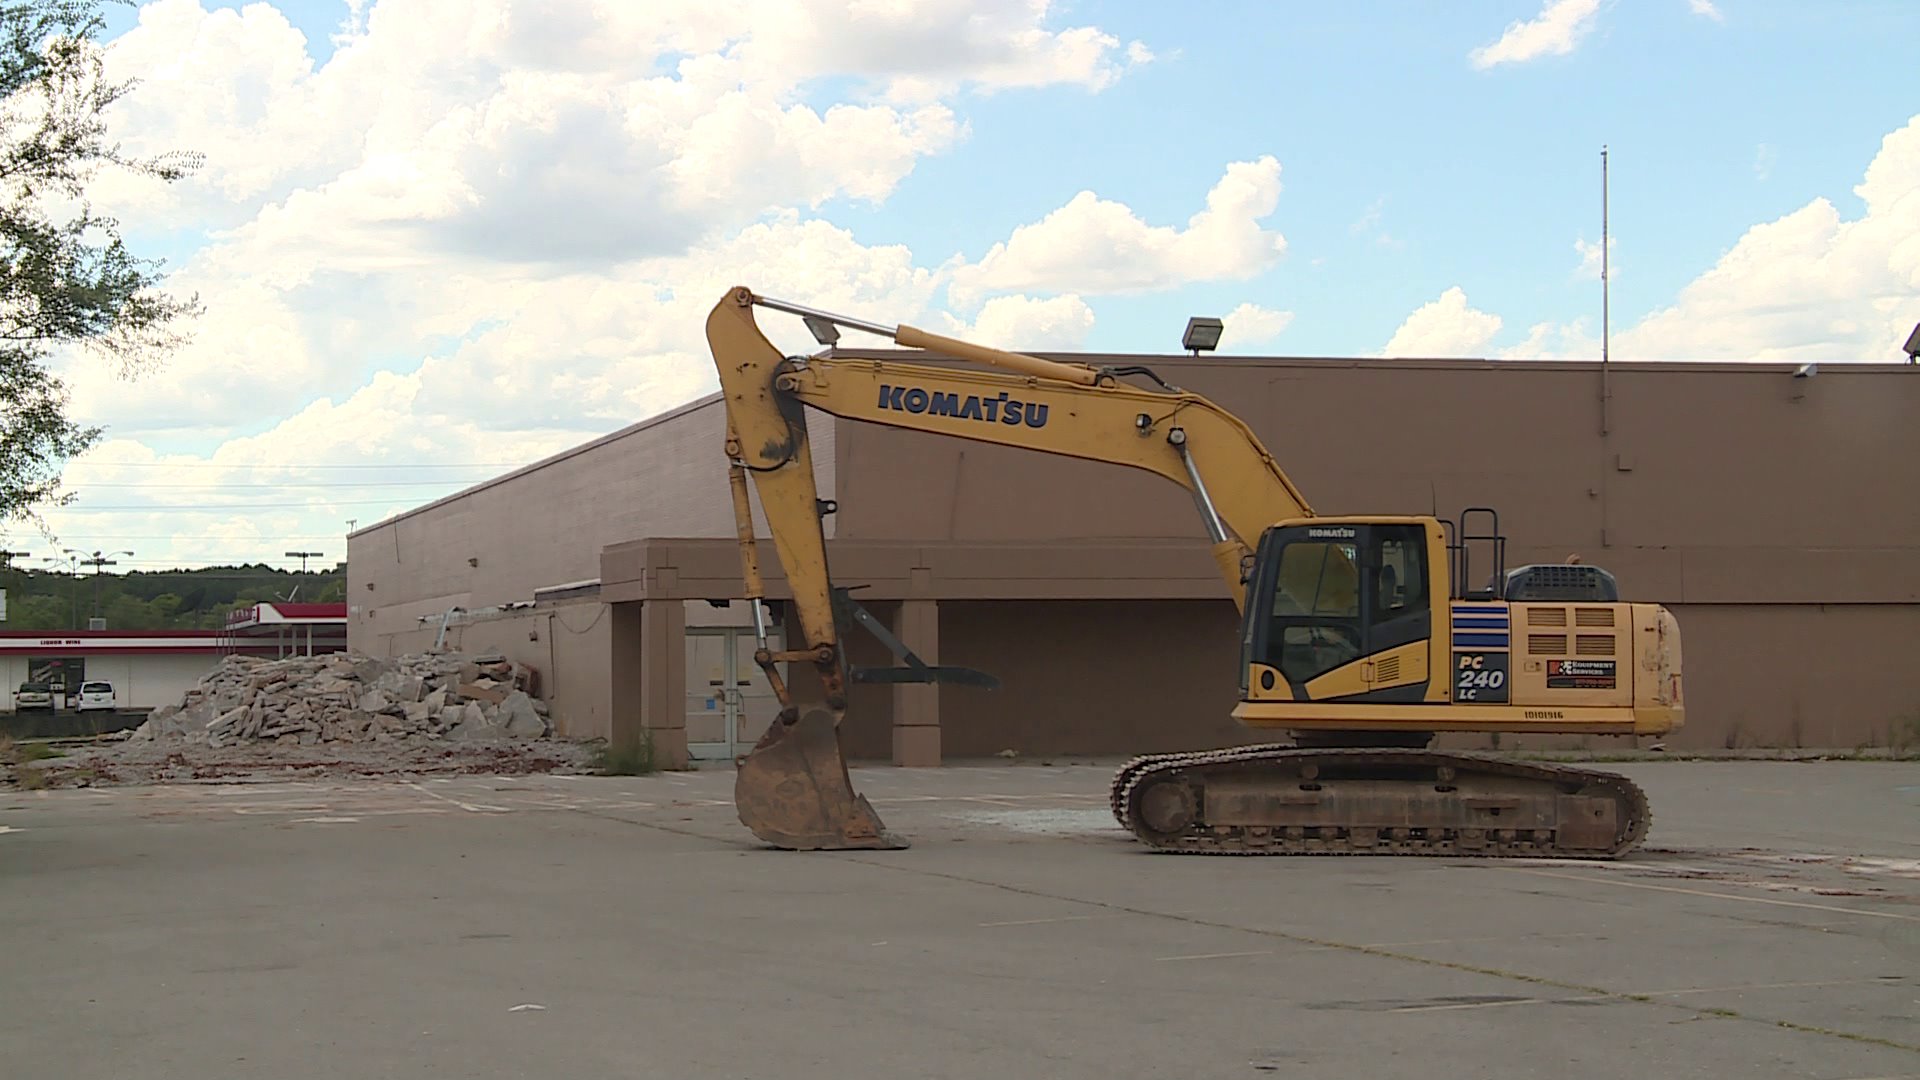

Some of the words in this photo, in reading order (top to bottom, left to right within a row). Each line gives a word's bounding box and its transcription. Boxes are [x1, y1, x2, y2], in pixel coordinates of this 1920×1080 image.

[878, 384, 1049, 428] KOMATSU
[1309, 528, 1355, 538] KOMATSU
[1459, 655, 1484, 669] PC
[1458, 670, 1504, 688] 240
[1459, 689, 1477, 700] LC
